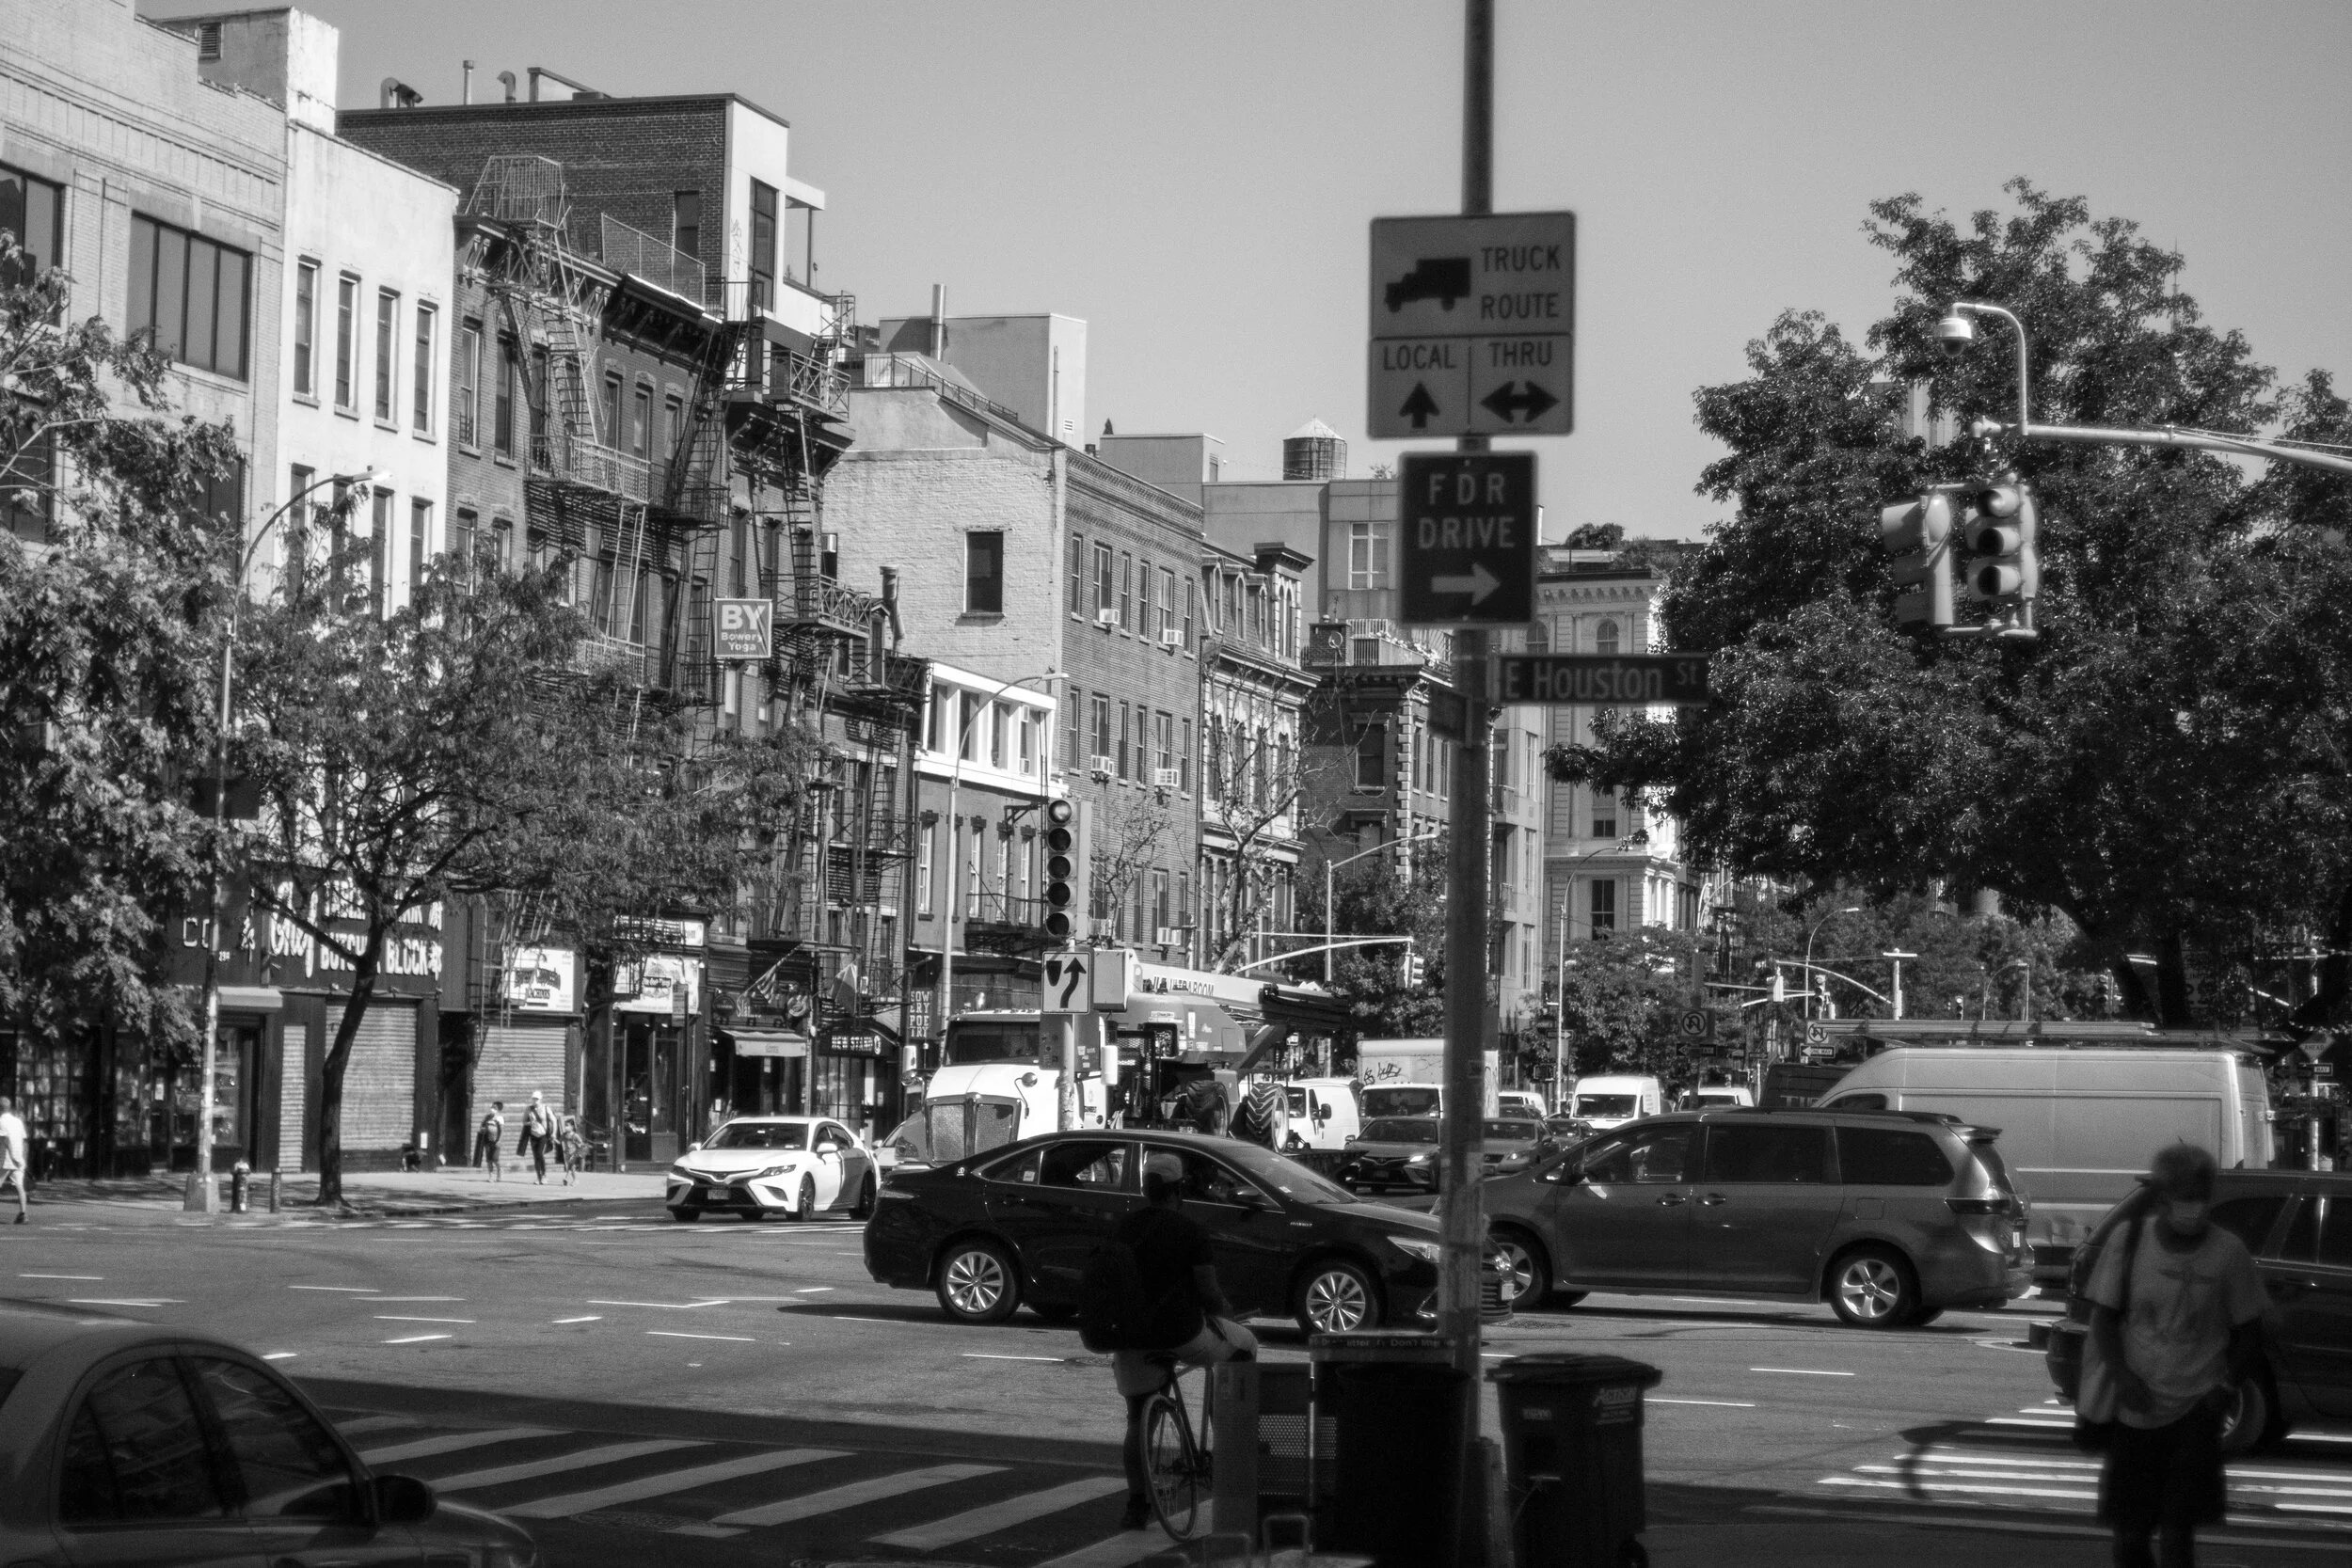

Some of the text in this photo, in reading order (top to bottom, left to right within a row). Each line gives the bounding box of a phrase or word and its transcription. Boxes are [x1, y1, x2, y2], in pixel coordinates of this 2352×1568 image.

[1480, 245, 1562, 273] TRUCK
[1480, 293, 1560, 321] ROUTE
[1383, 343, 1457, 371] LOCAL
[1489, 341, 1553, 368] THRU
[1418, 516, 1516, 548] DRIVE
[722, 604, 766, 630] BY
[721, 631, 763, 642] Bowery
[728, 641, 756, 653] Yoga
[1505, 661, 1521, 700] E
[1533, 660, 1663, 701] Houston
[386, 938, 428, 976] BLOCK
[909, 1015, 930, 1026] POE
